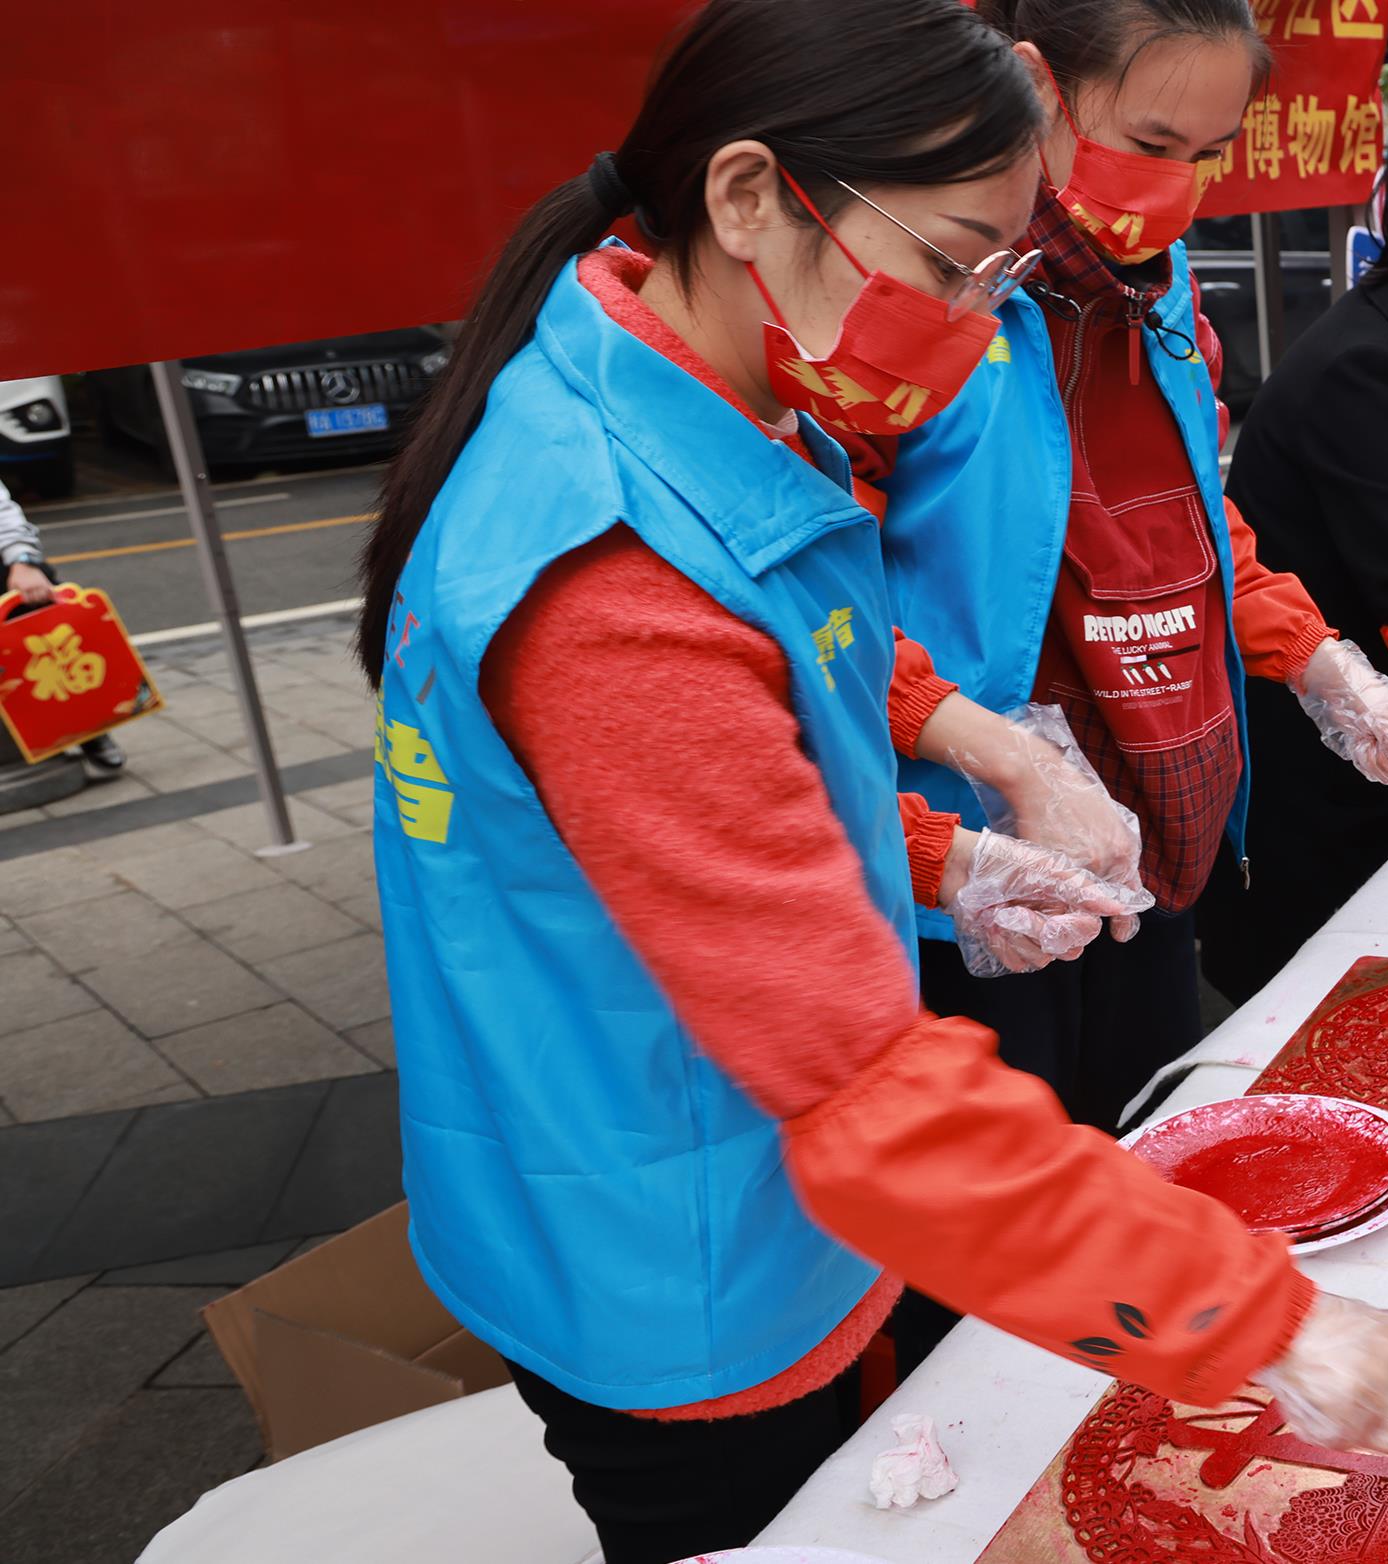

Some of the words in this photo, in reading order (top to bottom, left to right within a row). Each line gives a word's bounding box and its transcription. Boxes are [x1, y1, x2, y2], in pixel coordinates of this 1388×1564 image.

[1083, 613, 1143, 643] RETRO
[1141, 604, 1197, 639] NIGHT
[1121, 644, 1147, 655] LUCKY
[23, 623, 107, 702] 福
[1094, 689, 1120, 699] WILD
[1120, 689, 1129, 698] IN
